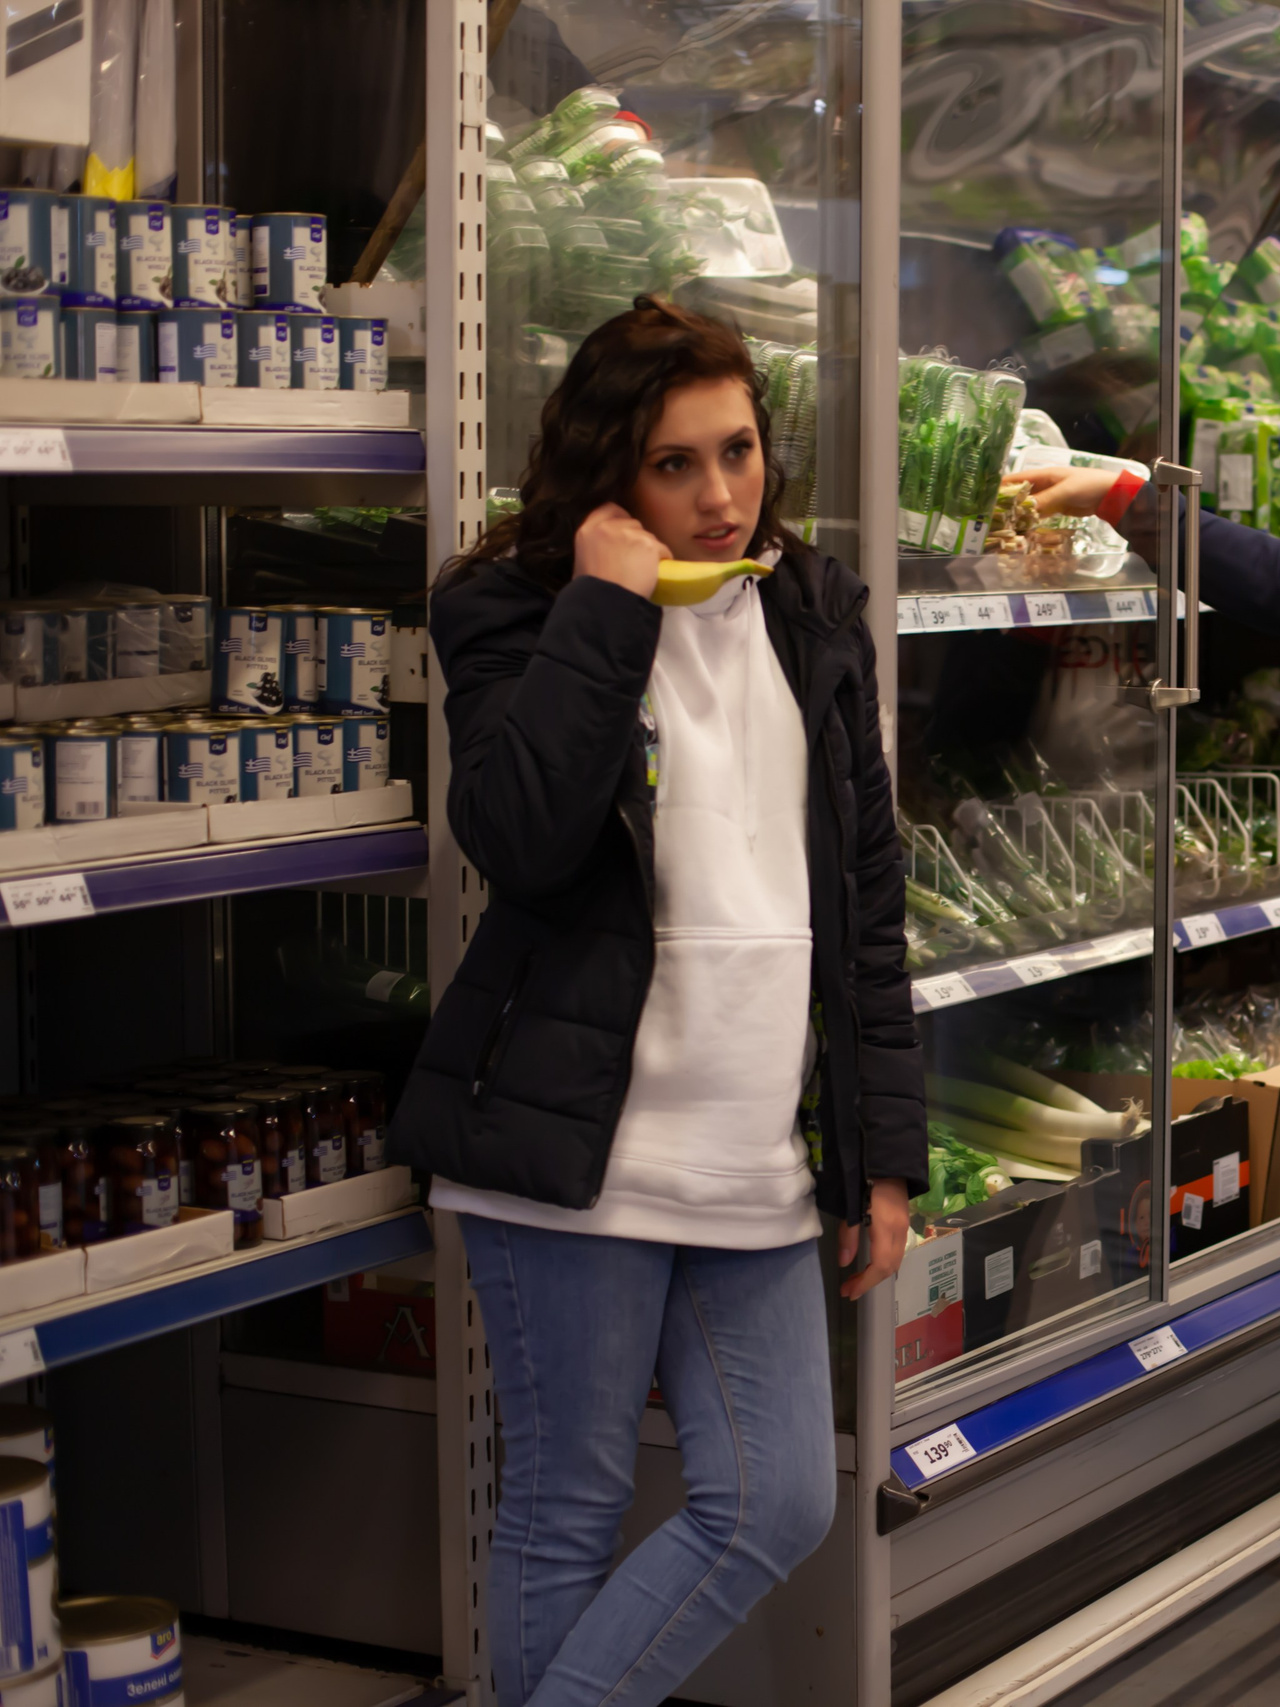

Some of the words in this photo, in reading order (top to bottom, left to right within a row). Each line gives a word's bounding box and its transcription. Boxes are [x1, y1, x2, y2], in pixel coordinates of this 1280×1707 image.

[977, 607, 990, 621] 44
[1035, 602, 1053, 617] 249
[931, 610, 945, 625] 39
[924, 1443, 949, 1464] 139
[157, 1631, 172, 1646] aro
